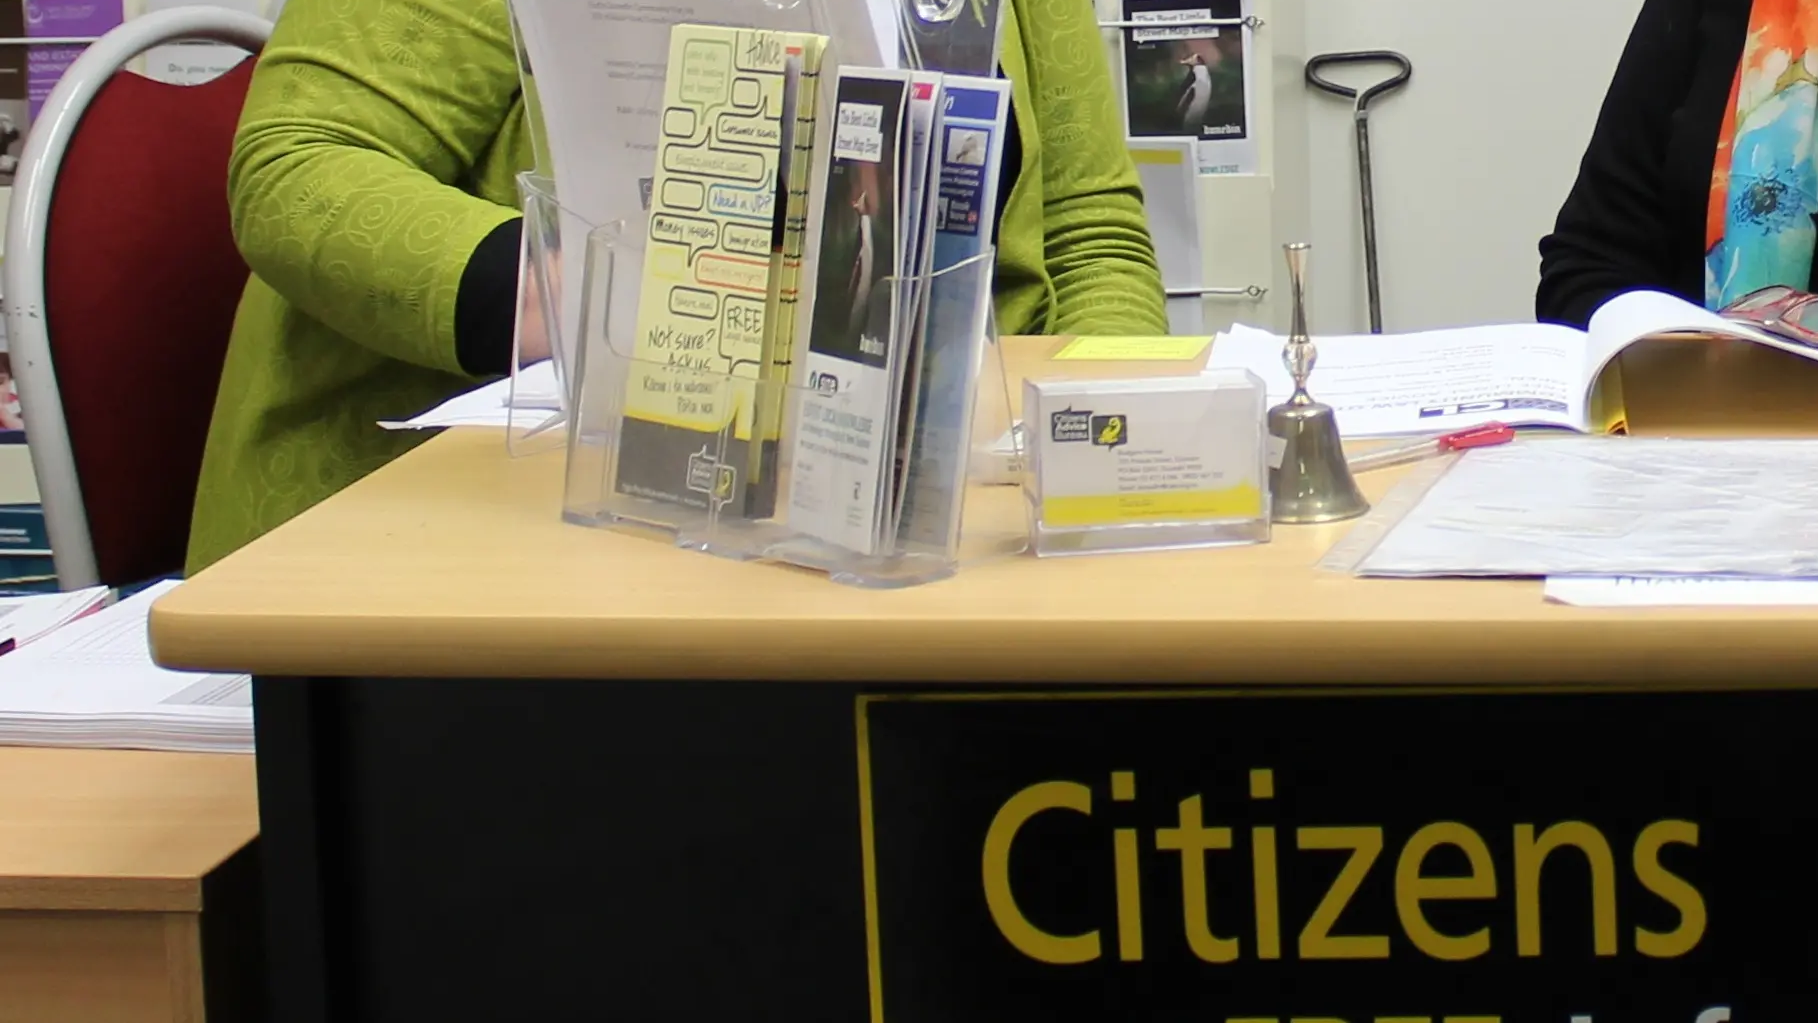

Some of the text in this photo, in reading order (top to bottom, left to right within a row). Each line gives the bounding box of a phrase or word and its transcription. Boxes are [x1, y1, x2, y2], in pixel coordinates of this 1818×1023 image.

[746, 36, 781, 65] Advice
[727, 307, 762, 331] FREE
[648, 327, 715, 350] Not sure?
[976, 766, 1708, 966] Citizens
